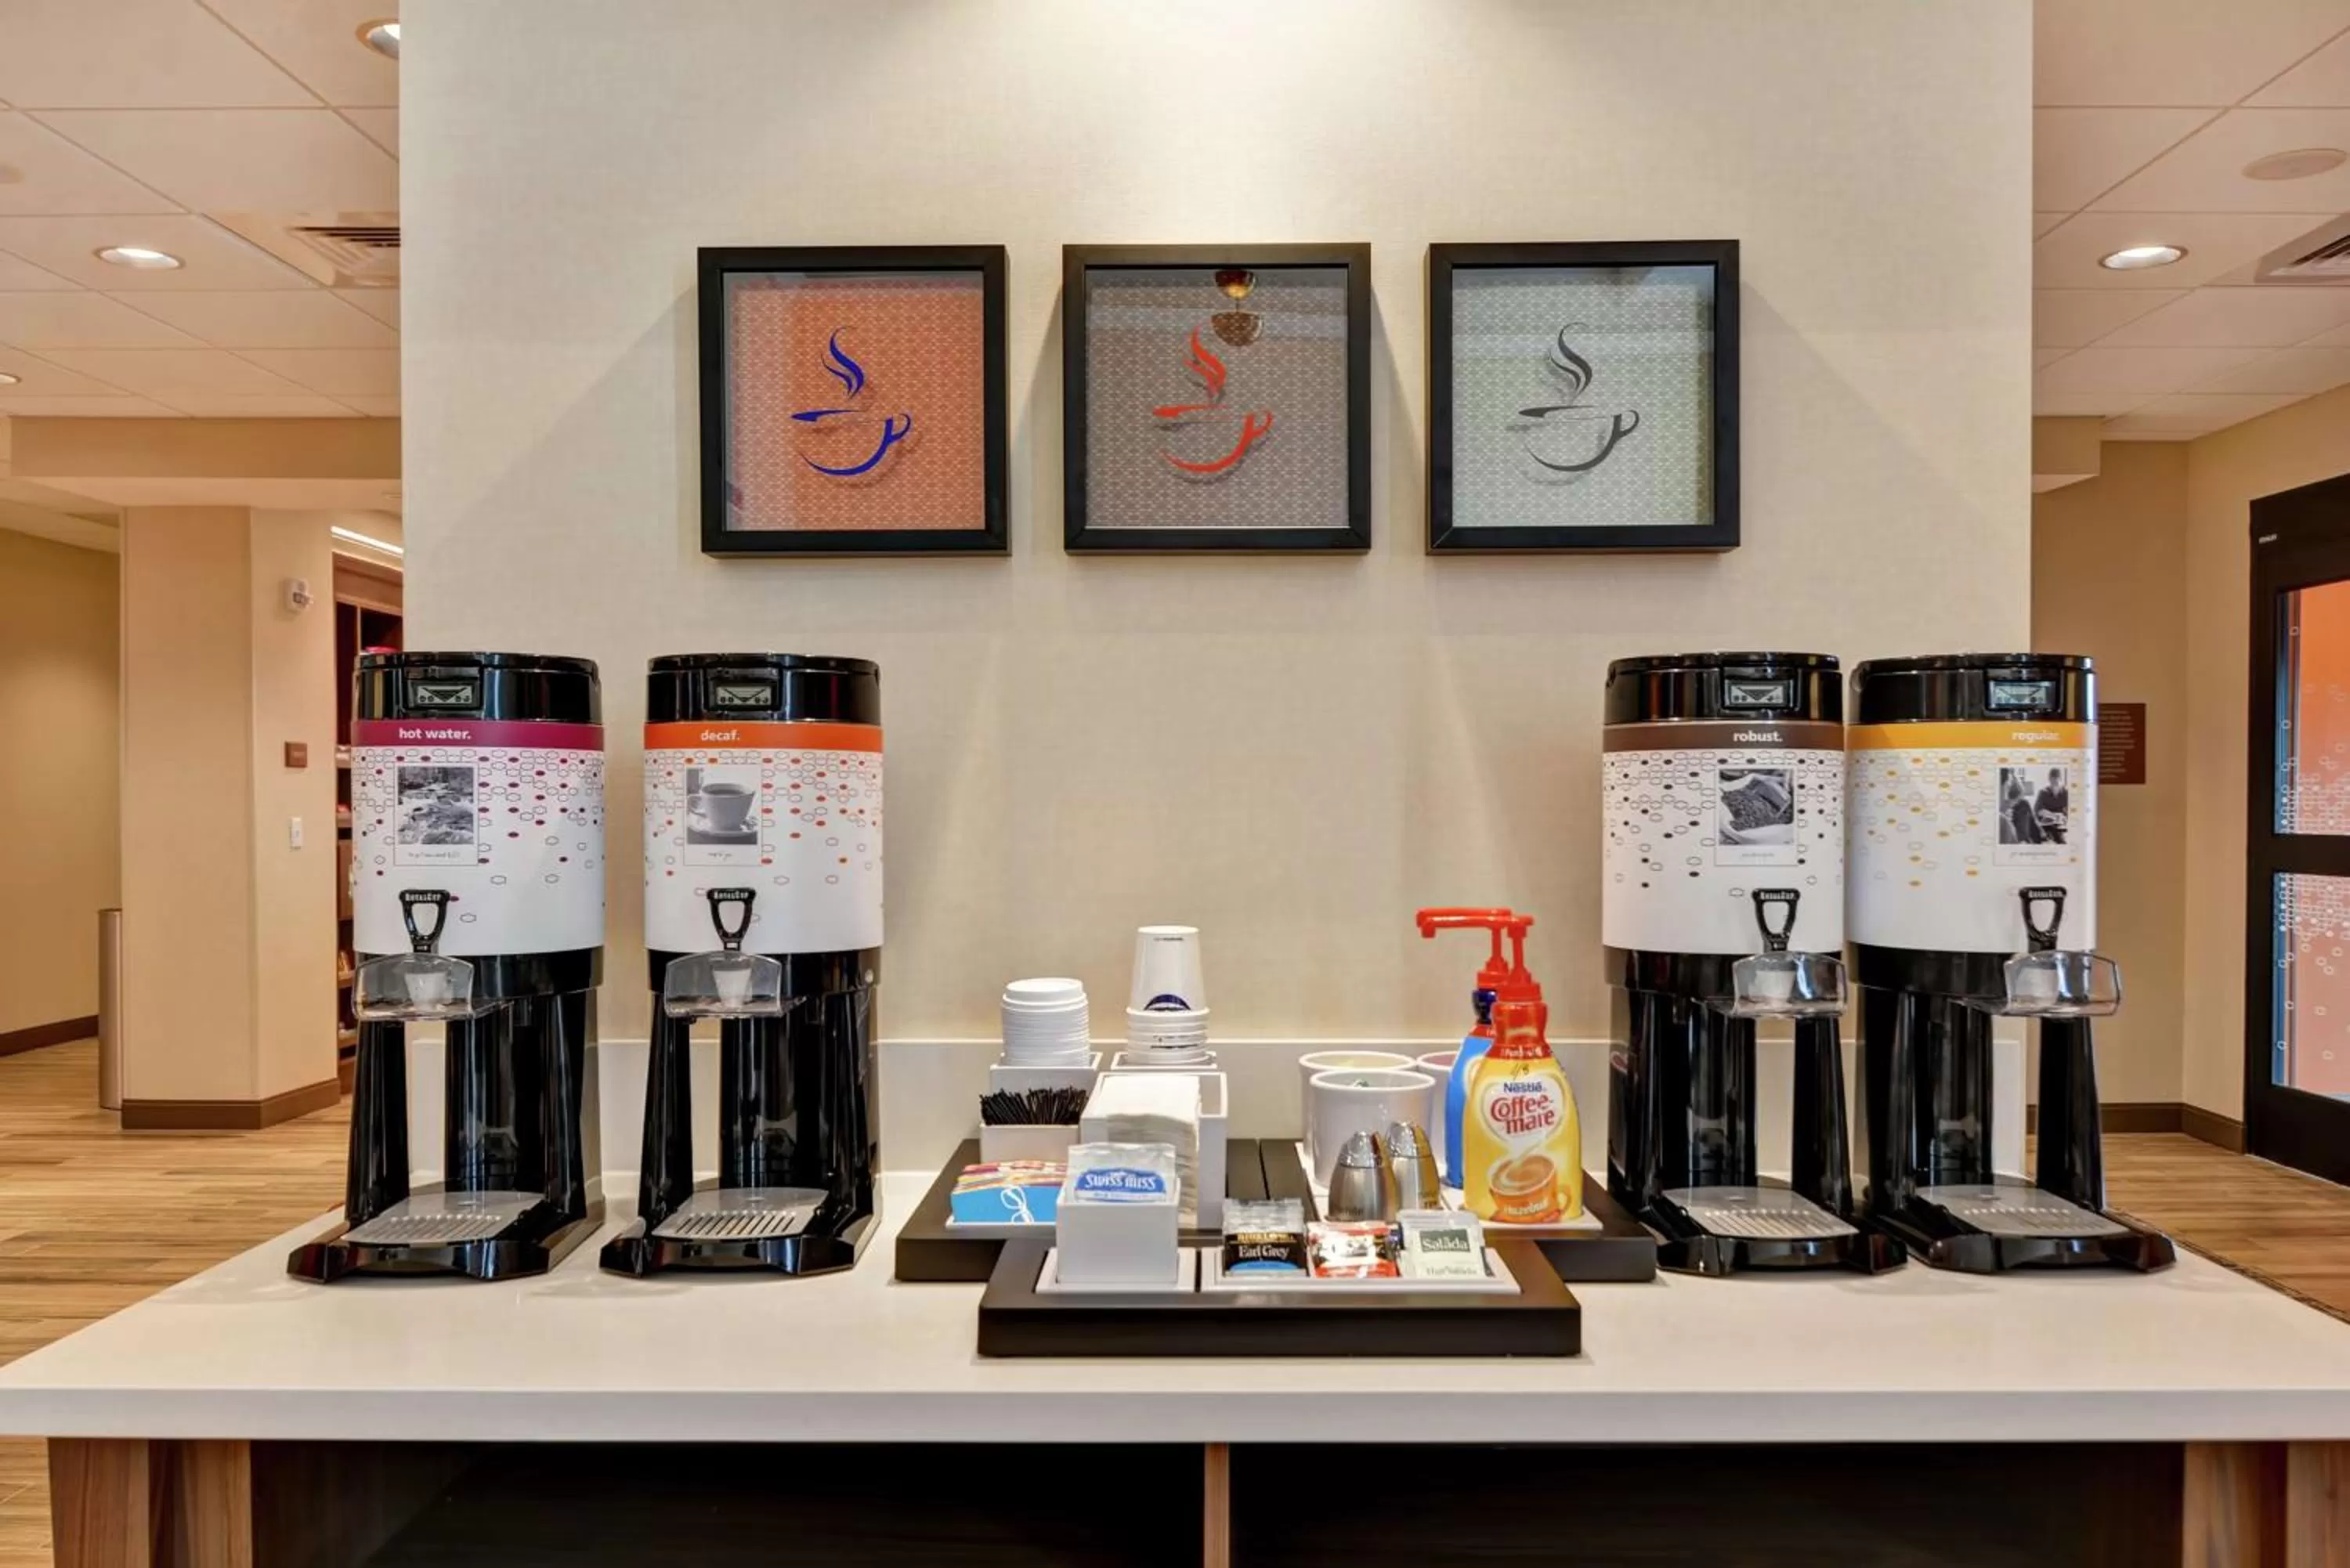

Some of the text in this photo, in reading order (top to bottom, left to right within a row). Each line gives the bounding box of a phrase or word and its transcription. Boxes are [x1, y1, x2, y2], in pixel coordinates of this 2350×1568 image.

[399, 727, 472, 739] hot water.
[701, 729, 740, 741] decaf.
[1733, 730, 1783, 742] robust.
[1506, 1110, 1555, 1134] mate
[1238, 1245, 1290, 1260] Earl Grey
